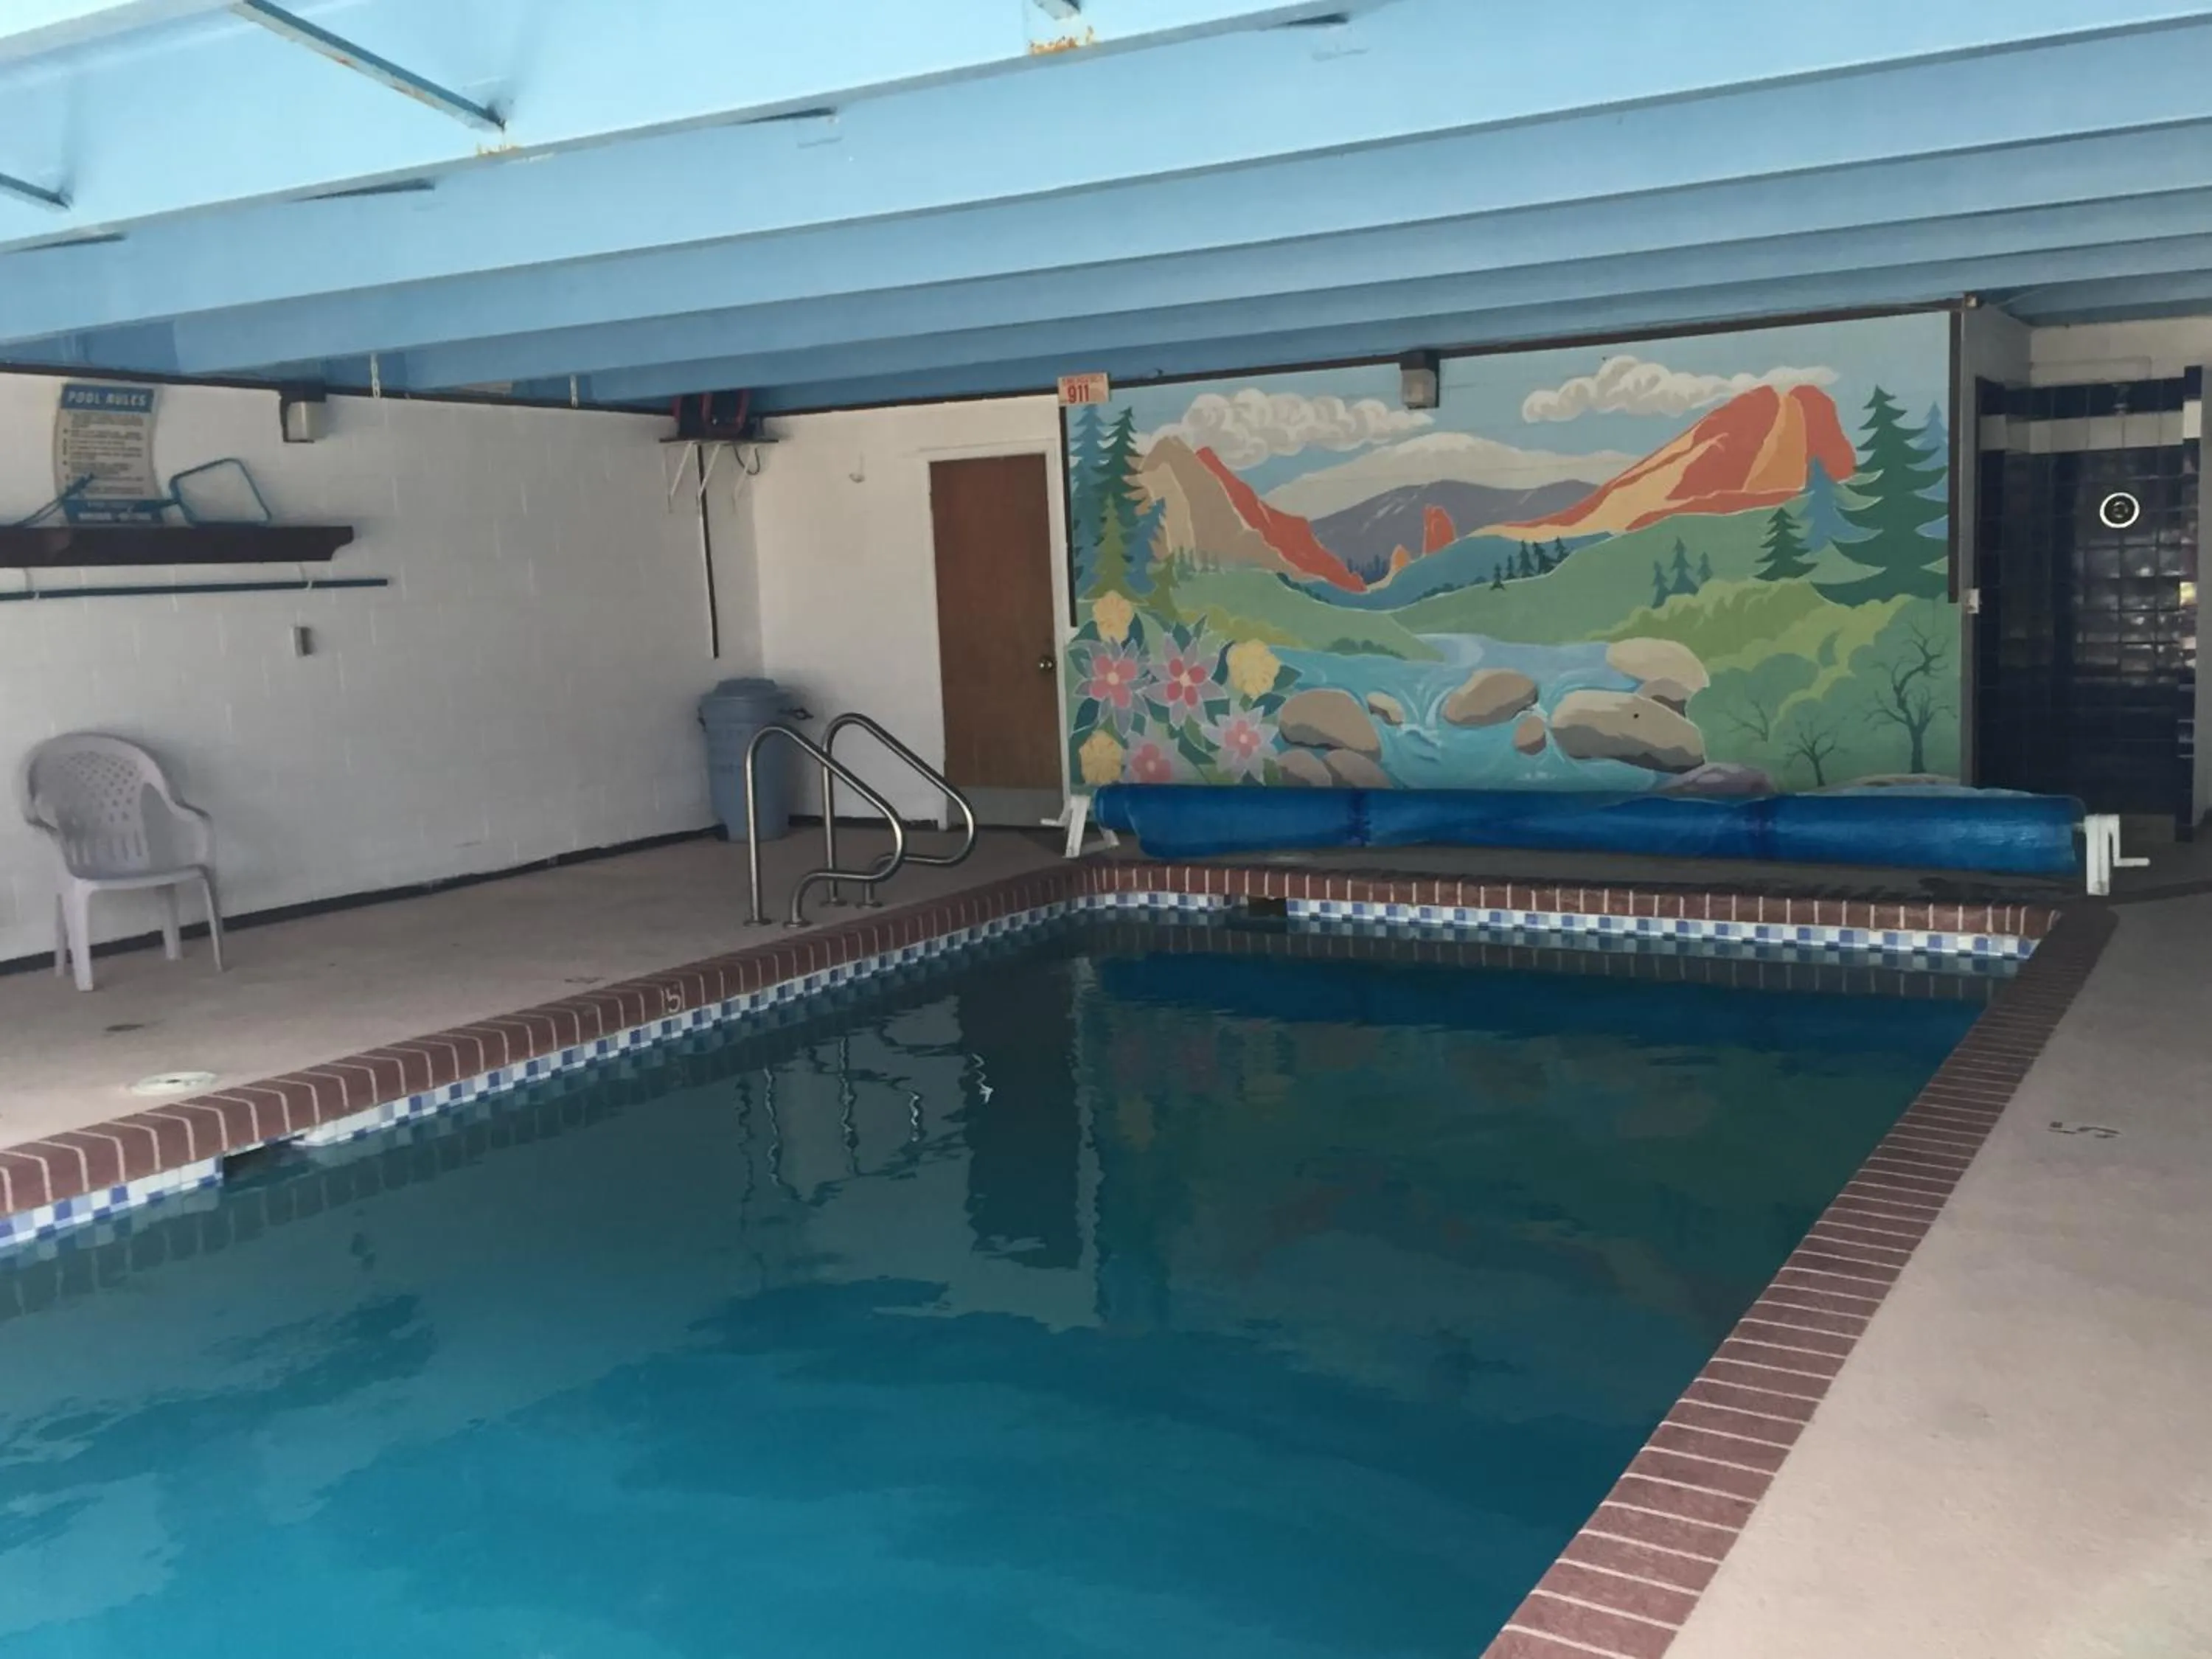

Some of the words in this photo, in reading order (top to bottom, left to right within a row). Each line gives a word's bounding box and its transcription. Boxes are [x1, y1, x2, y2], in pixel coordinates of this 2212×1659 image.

[68, 391, 100, 405] POOL
[105, 393, 146, 406] RULES
[1067, 385, 1089, 404] 911
[665, 986, 681, 1013] 5
